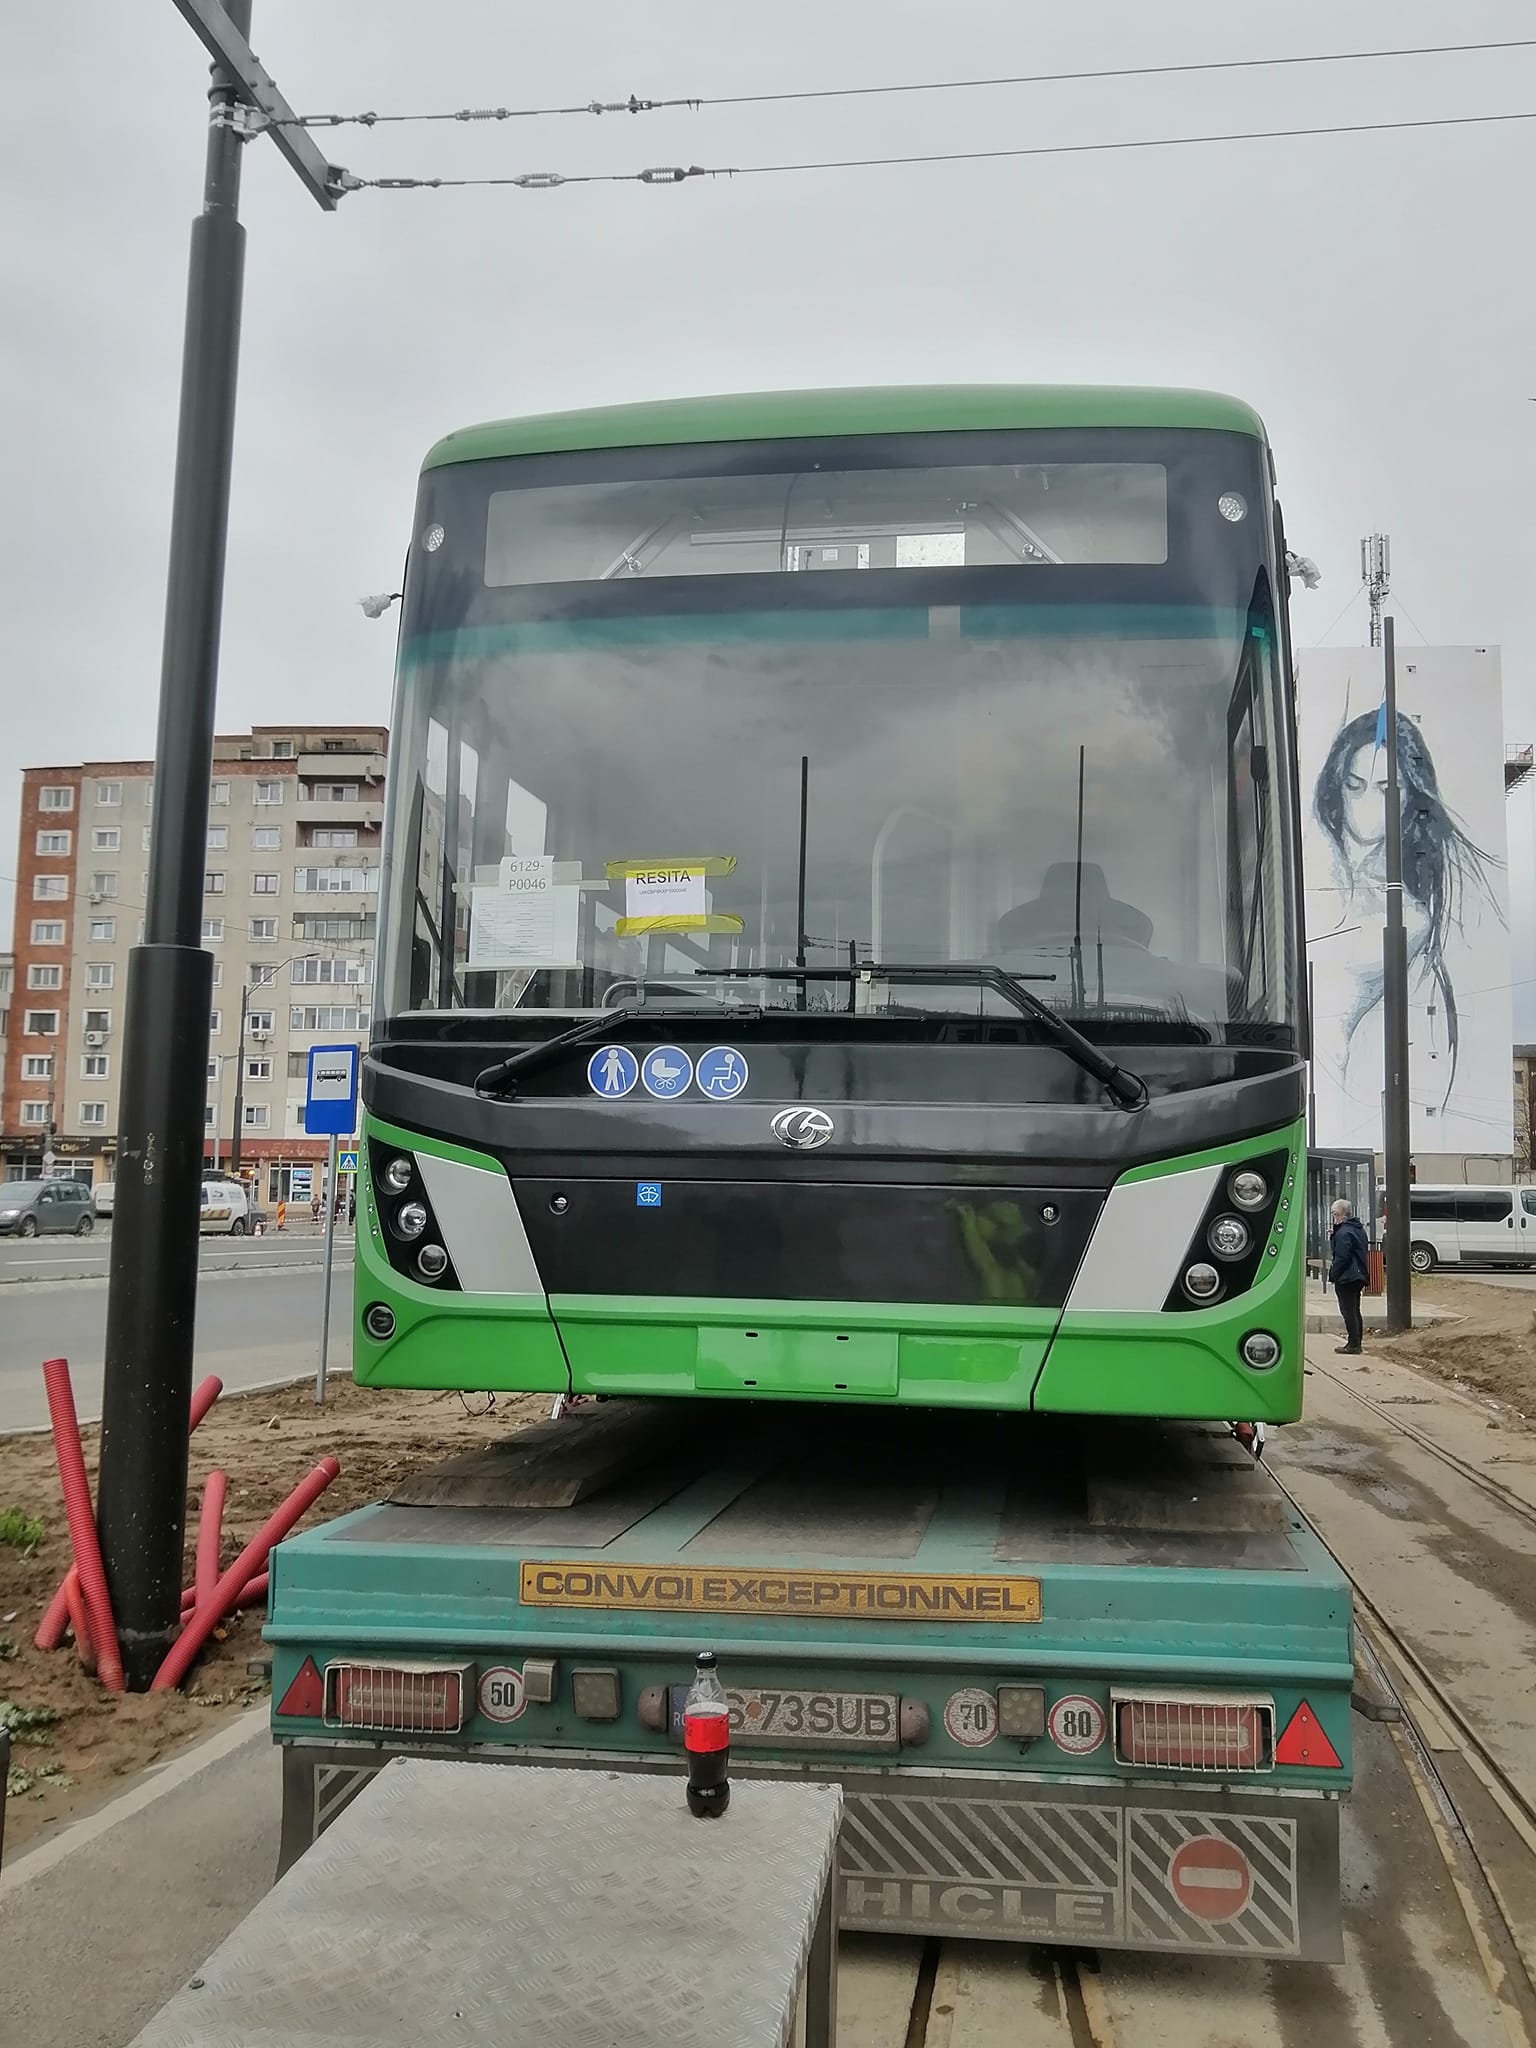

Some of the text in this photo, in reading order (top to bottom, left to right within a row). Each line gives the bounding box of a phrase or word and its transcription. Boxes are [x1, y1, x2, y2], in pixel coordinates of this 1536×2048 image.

[510, 860, 545, 872] 6129-
[636, 870, 691, 885] RESITA
[509, 878, 546, 890] P0046
[536, 1571, 1026, 1612] CONVOI EXCEPTIONNEL
[491, 1682, 515, 1707] 50
[960, 1704, 987, 1731] 70
[1063, 1710, 1092, 1737] 80
[846, 1879, 1105, 1929] HICLE
